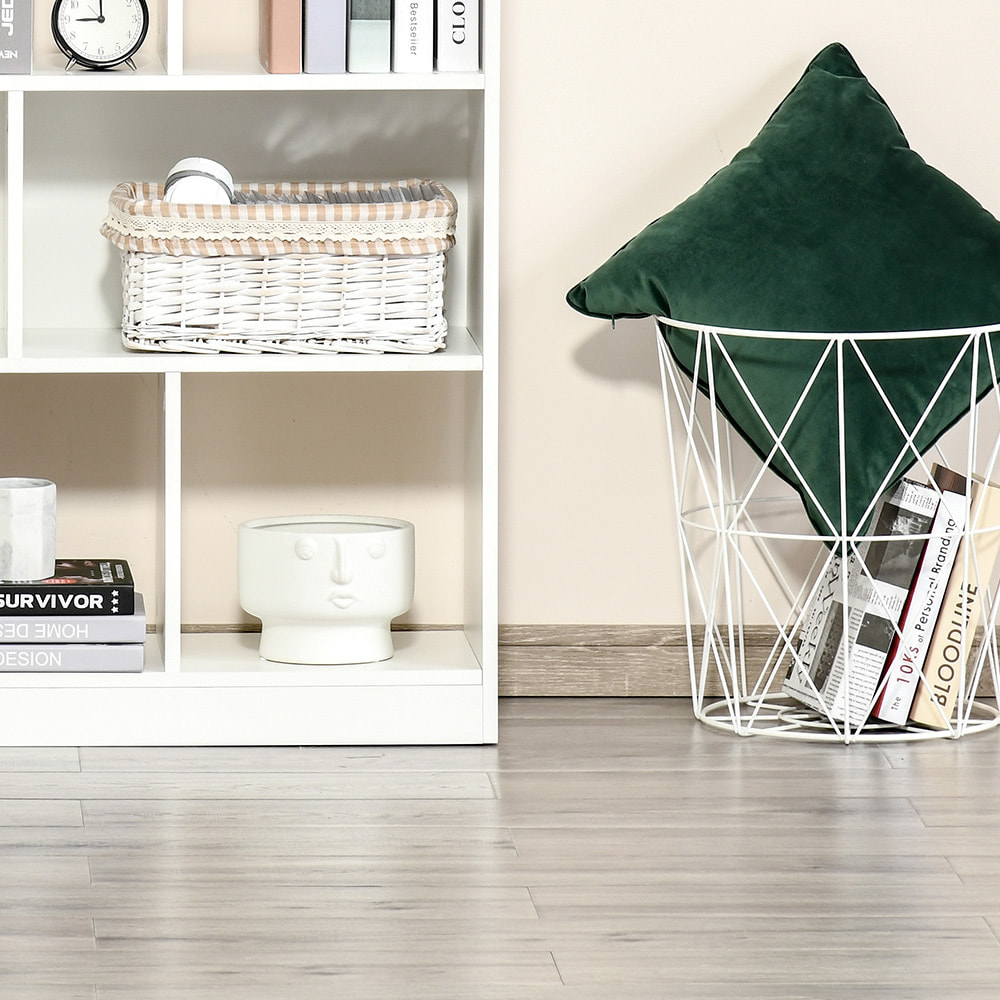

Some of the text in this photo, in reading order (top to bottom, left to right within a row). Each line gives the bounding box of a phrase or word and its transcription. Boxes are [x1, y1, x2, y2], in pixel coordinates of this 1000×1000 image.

[70, 0, 79, 9] 10
[126, 0, 132, 7] 2
[64, 15, 70, 24] 9
[131, 15, 137, 24] 3
[70, 31, 76, 40] 8
[125, 30, 131, 39] 4
[82, 42, 88, 51] 7
[98, 46, 104, 55] 6
[115, 43, 120, 51] 5
[890, 696, 902, 711] The
[917, 632, 924, 644] of
[931, 518, 956, 574] Brandng
[34, 623, 89, 638] HOME
